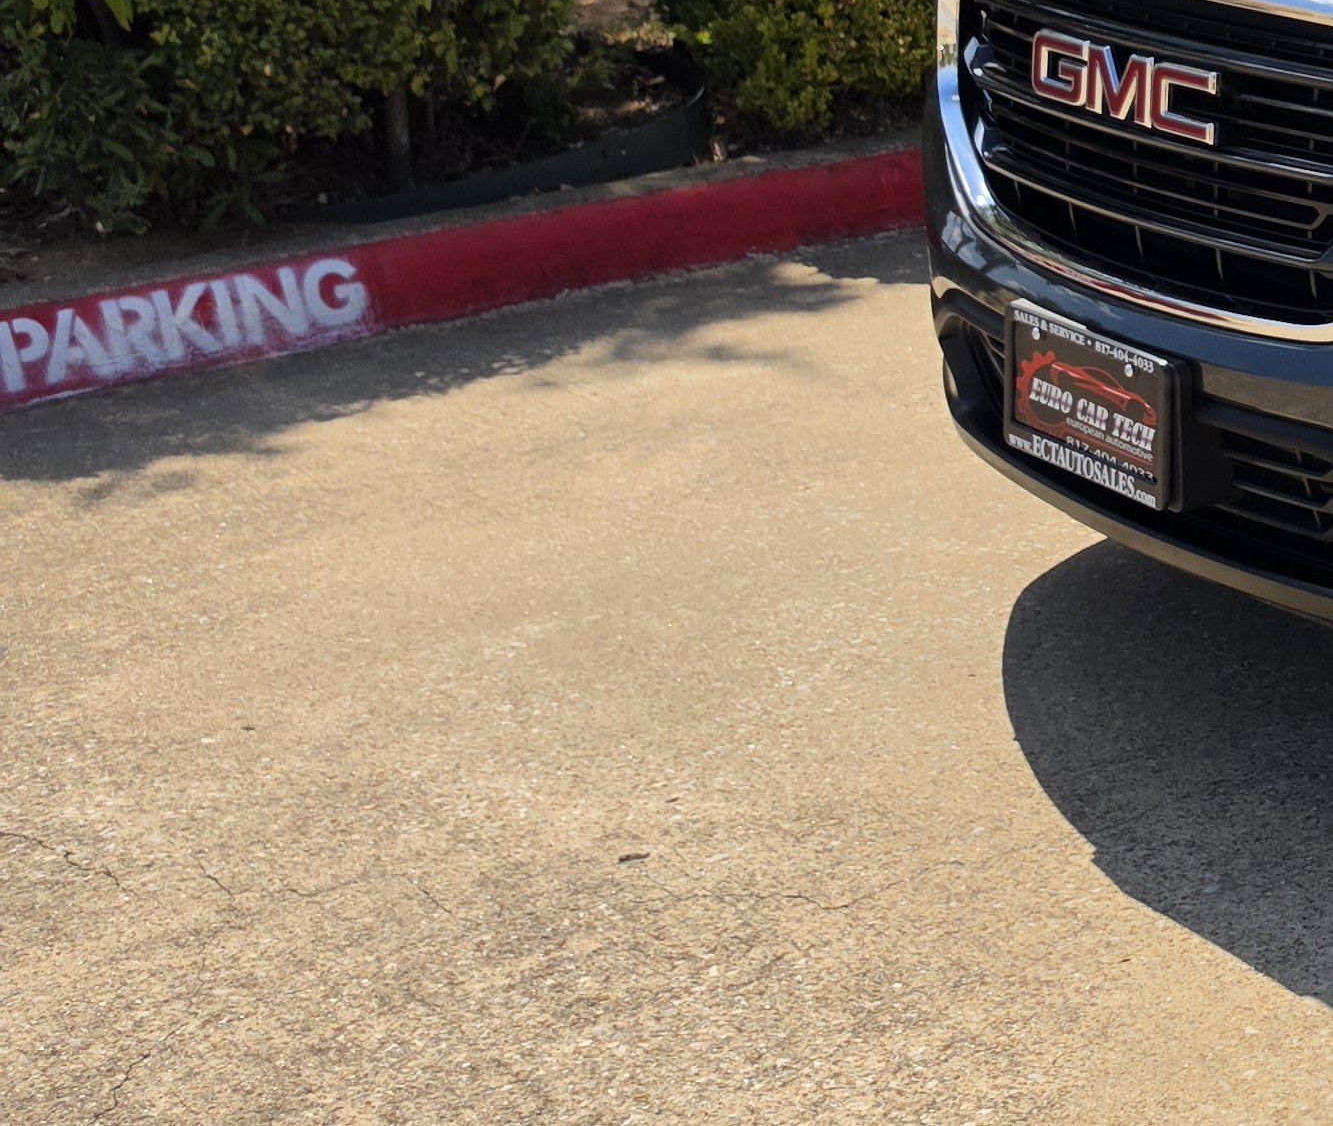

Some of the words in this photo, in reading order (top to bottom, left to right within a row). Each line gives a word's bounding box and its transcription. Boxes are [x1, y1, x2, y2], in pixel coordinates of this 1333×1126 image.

[1031, 28, 1221, 146] GMC
[0, 257, 370, 394] PARKING
[1014, 310, 1040, 327] SALES
[1040, 320, 1048, 331] &
[1049, 324, 1085, 346] SERVICE
[1095, 341, 1154, 374] 817-404-4033
[1029, 377, 1073, 415] EURO
[1077, 398, 1110, 430] CAR
[1113, 413, 1156, 452] TECH
[1065, 416, 1105, 441] european
[1105, 434, 1154, 462] automotive
[1008, 432, 1157, 509] www.ECTAUTOSALES.com
